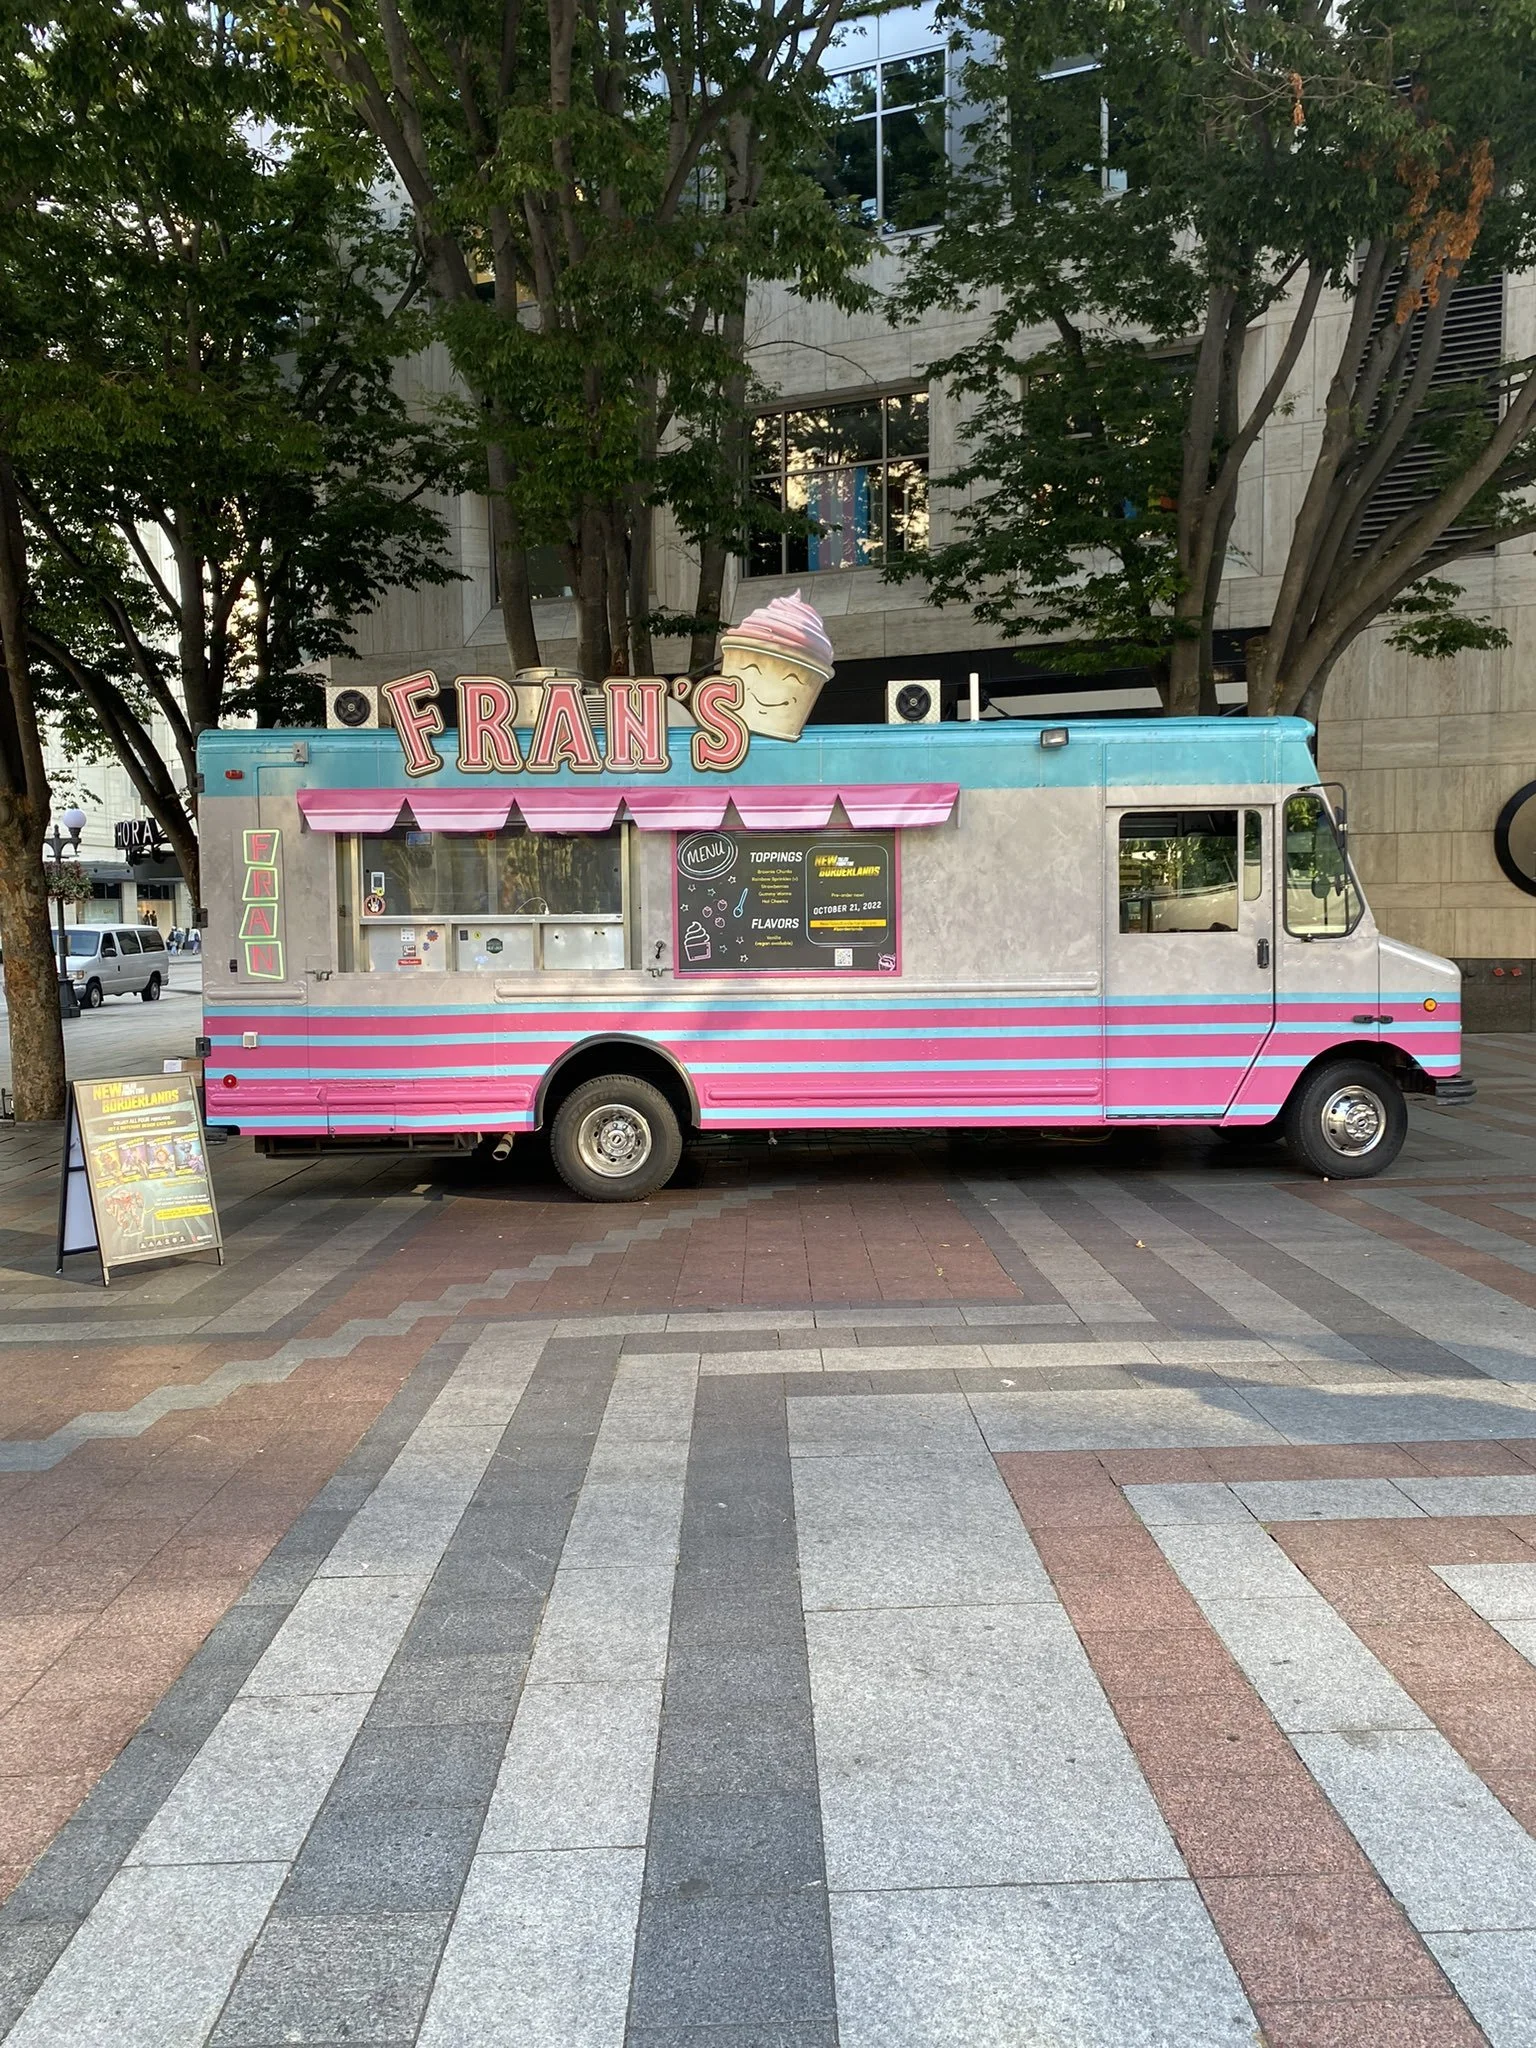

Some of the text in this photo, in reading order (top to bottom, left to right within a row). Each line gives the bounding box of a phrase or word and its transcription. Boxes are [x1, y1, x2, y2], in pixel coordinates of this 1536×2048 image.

[381, 669, 751, 778] FRAN'S
[687, 840, 726, 866] MENU
[750, 851, 803, 863] TOPPINGS
[814, 855, 838, 867] NEW
[818, 866, 881, 878] BORDERLANDS
[247, 833, 273, 972] FRAN
[813, 901, 882, 916] OCTOBER 21, 2022
[751, 917, 800, 929] FLAVORS
[93, 1082, 122, 1101] NEW
[102, 1089, 179, 1114] BORDERLANDS
